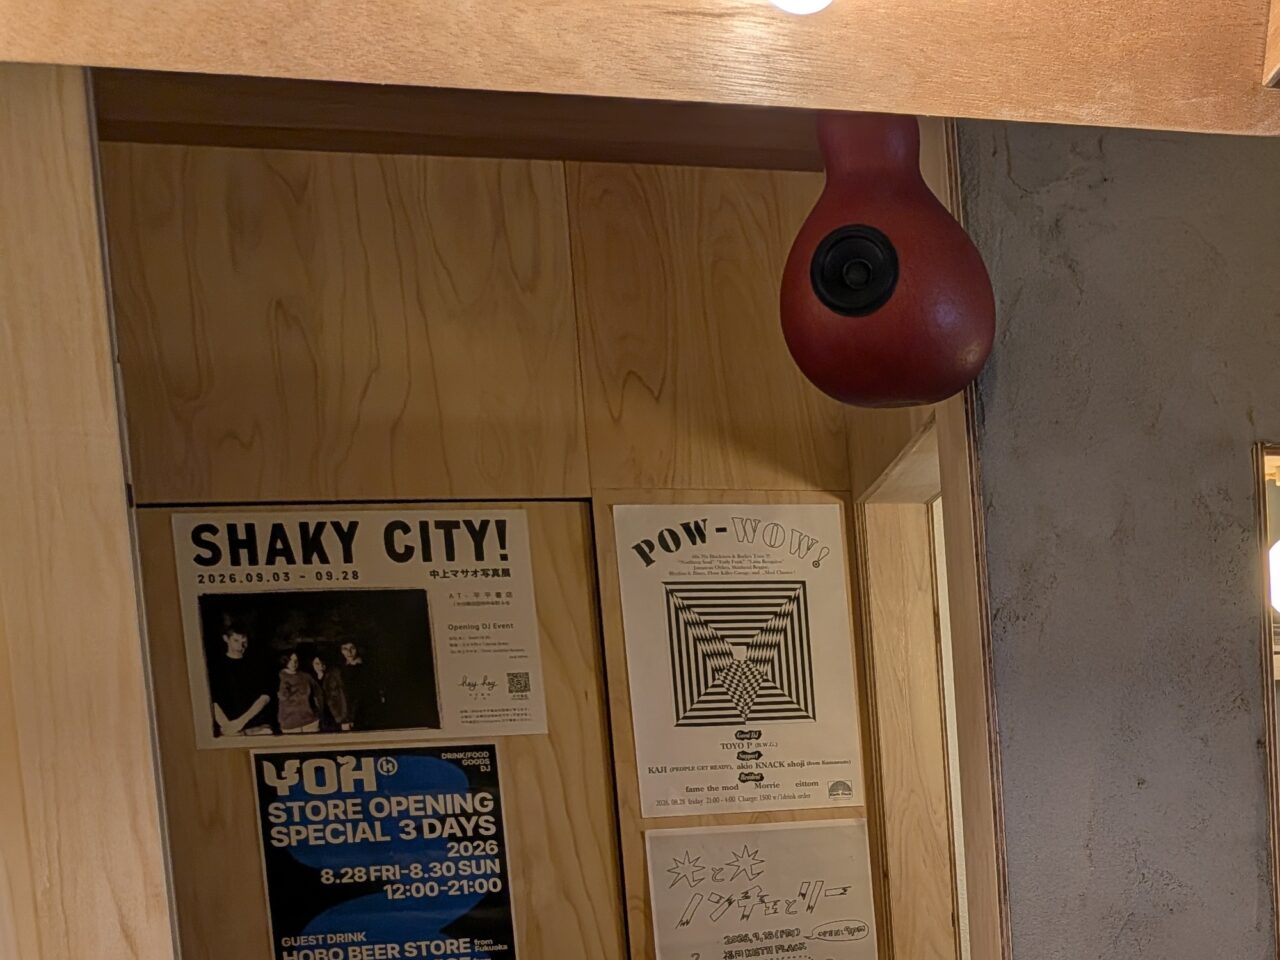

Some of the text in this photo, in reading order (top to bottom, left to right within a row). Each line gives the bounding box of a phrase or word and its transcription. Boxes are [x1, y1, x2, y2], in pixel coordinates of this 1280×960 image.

[190, 519, 509, 566] SHAKY CITY!
[197, 570, 360, 584] 2026.09.03 09.28
[719, 742, 744, 750] TOYO
[462, 758, 490, 766] GOODS
[755, 760, 786, 769] KNACK
[786, 760, 805, 769] shoji
[685, 785, 705, 793] fame
[706, 784, 720, 792] the
[721, 783, 739, 791] mod
[754, 781, 780, 789] Morrie
[267, 792, 495, 824] STORE OPENING
[270, 815, 497, 848] SPECIAL 3 DAYS
[446, 840, 499, 858] 2026
[383, 877, 503, 900] 12:00-21:00
[281, 932, 367, 947] GUEST DRINK
[404, 937, 472, 957] STORE
[473, 938, 493, 946] from
[474, 944, 508, 952] Fukuoka
